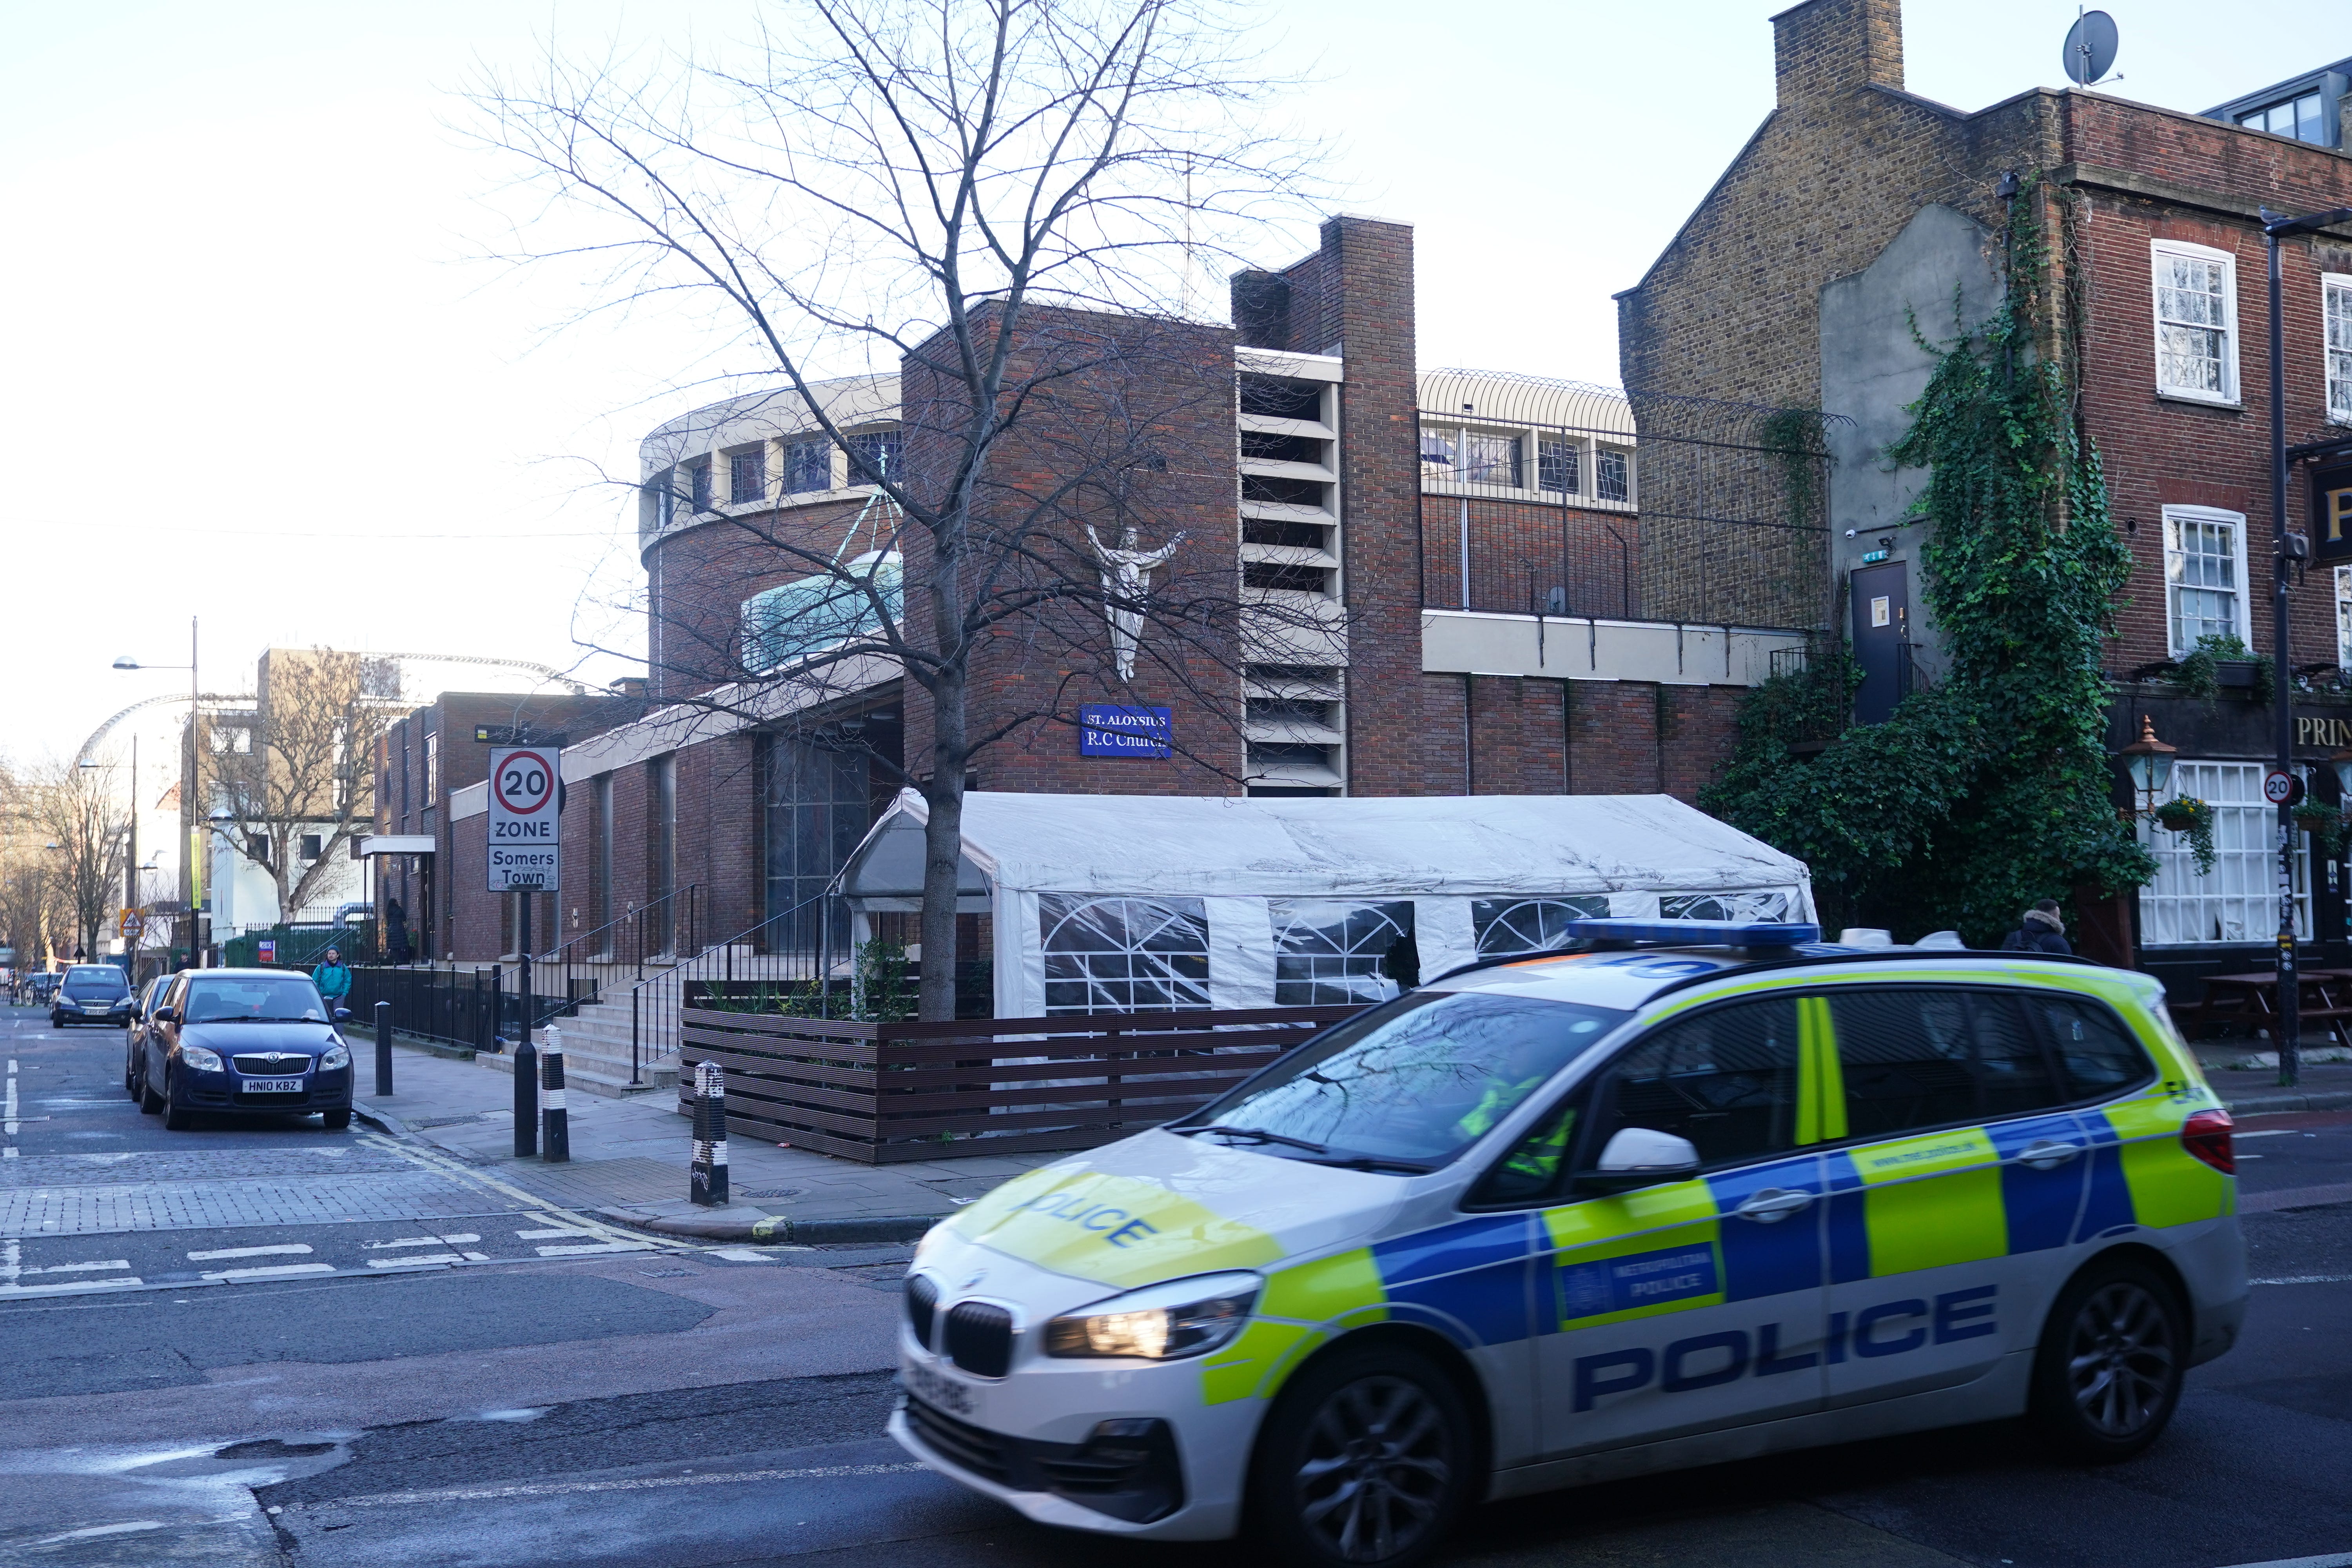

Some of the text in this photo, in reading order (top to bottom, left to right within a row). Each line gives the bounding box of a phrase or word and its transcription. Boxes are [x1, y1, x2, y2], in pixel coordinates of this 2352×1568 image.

[1087, 714, 1166, 726] ST. ALOYSIUS
[1087, 731, 1113, 746] R.C
[505, 770, 546, 795] 20
[2268, 780, 2288, 794] 20
[495, 822, 550, 837] ZONE
[493, 851, 554, 865] Somers
[502, 869, 545, 884] Town
[249, 1082, 296, 1091] HN10 KBZ
[1630, 1273, 1702, 1298] POLICE
[1571, 1284, 1998, 1413] POLICE
